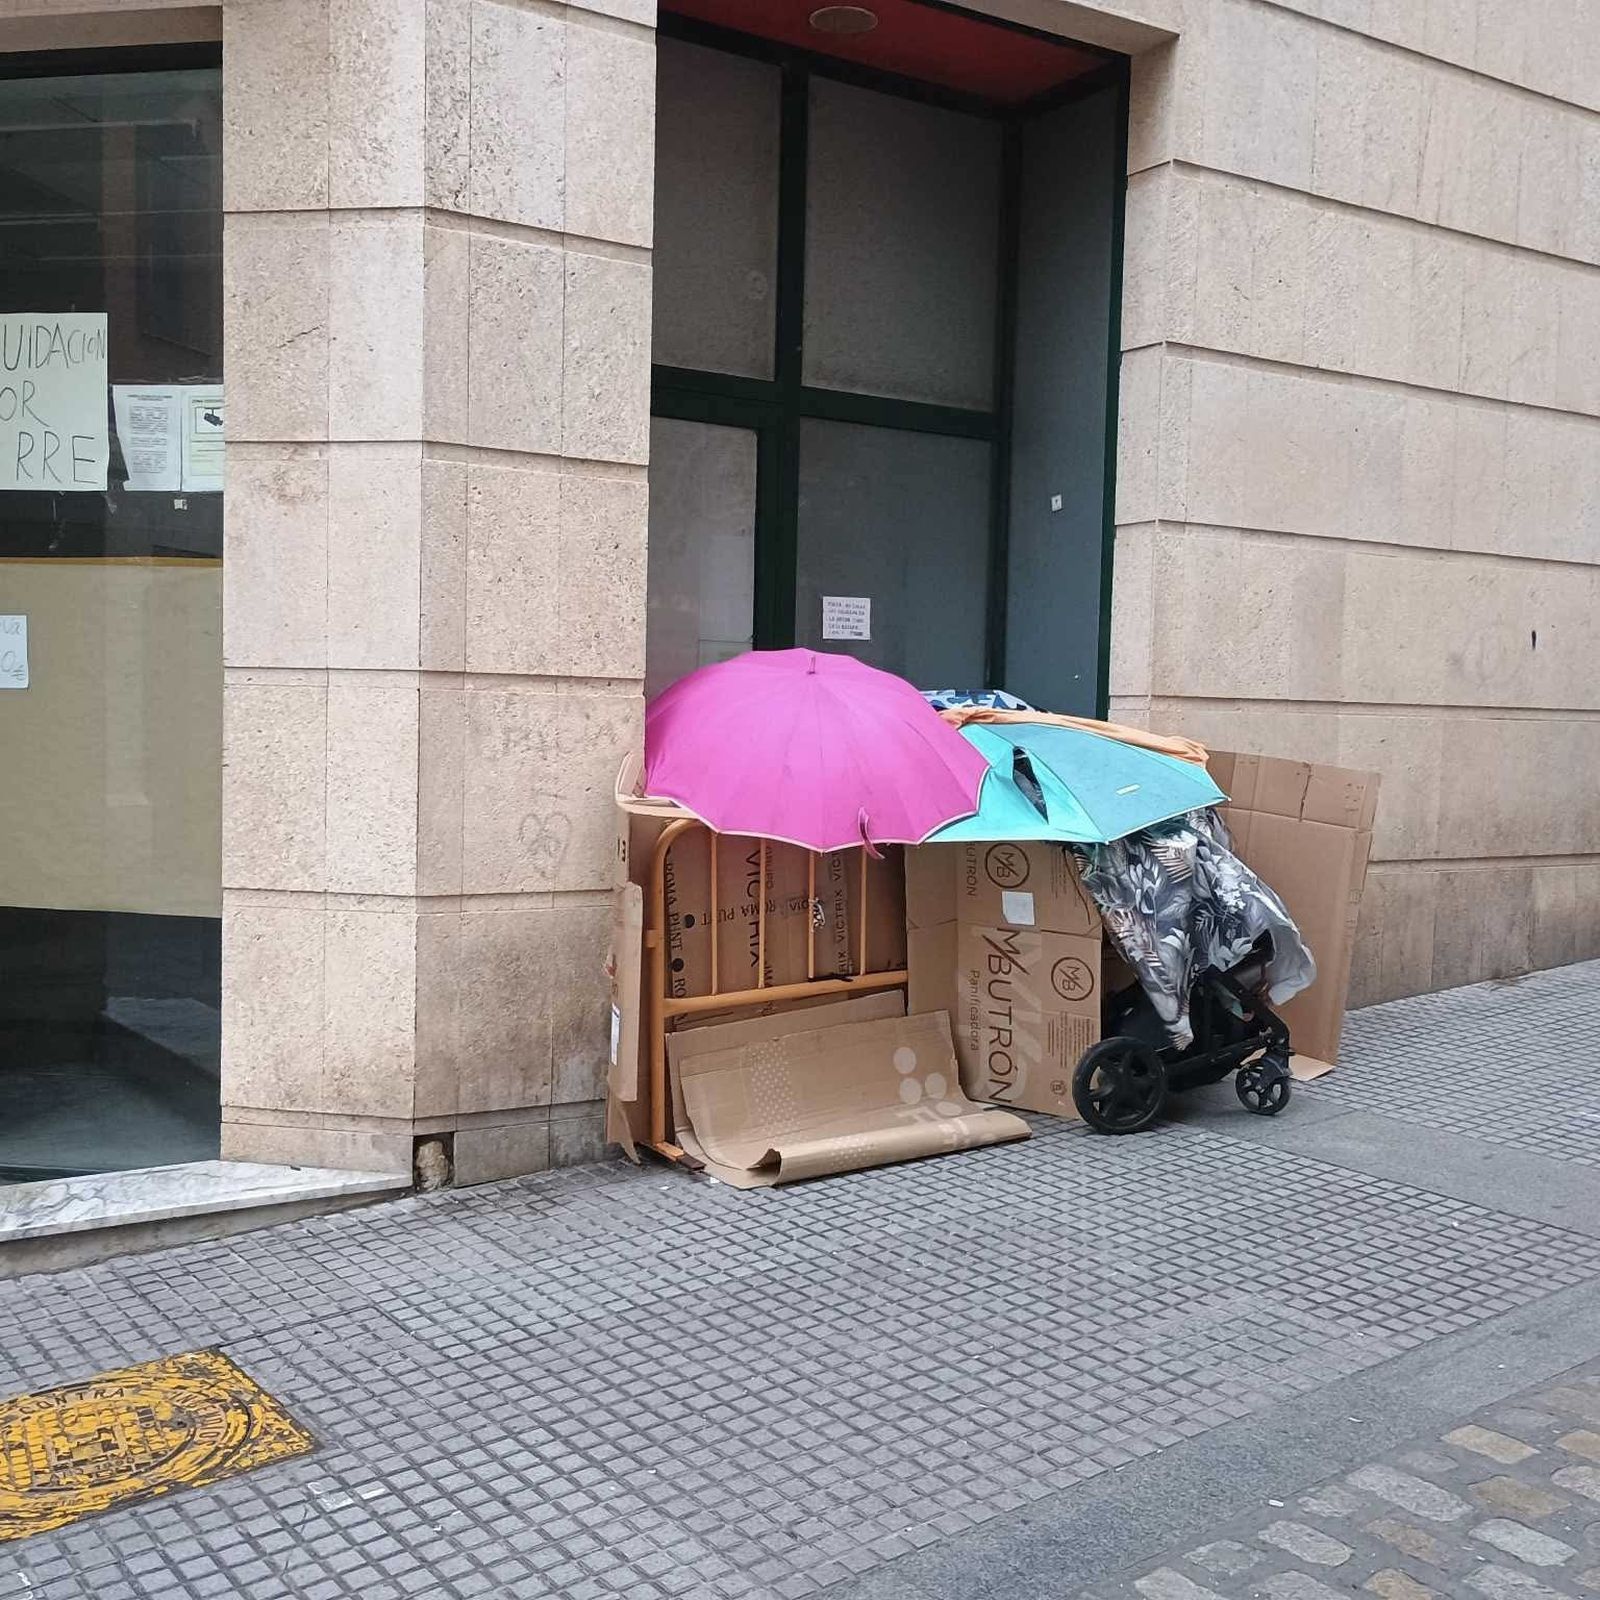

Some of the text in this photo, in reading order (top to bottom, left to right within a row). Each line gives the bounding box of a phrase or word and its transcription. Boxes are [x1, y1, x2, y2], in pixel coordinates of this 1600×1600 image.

[17, 431, 98, 484] RRE
[969, 970, 981, 1052] Panificadora
[19, 1388, 125, 1414] CONTRA
